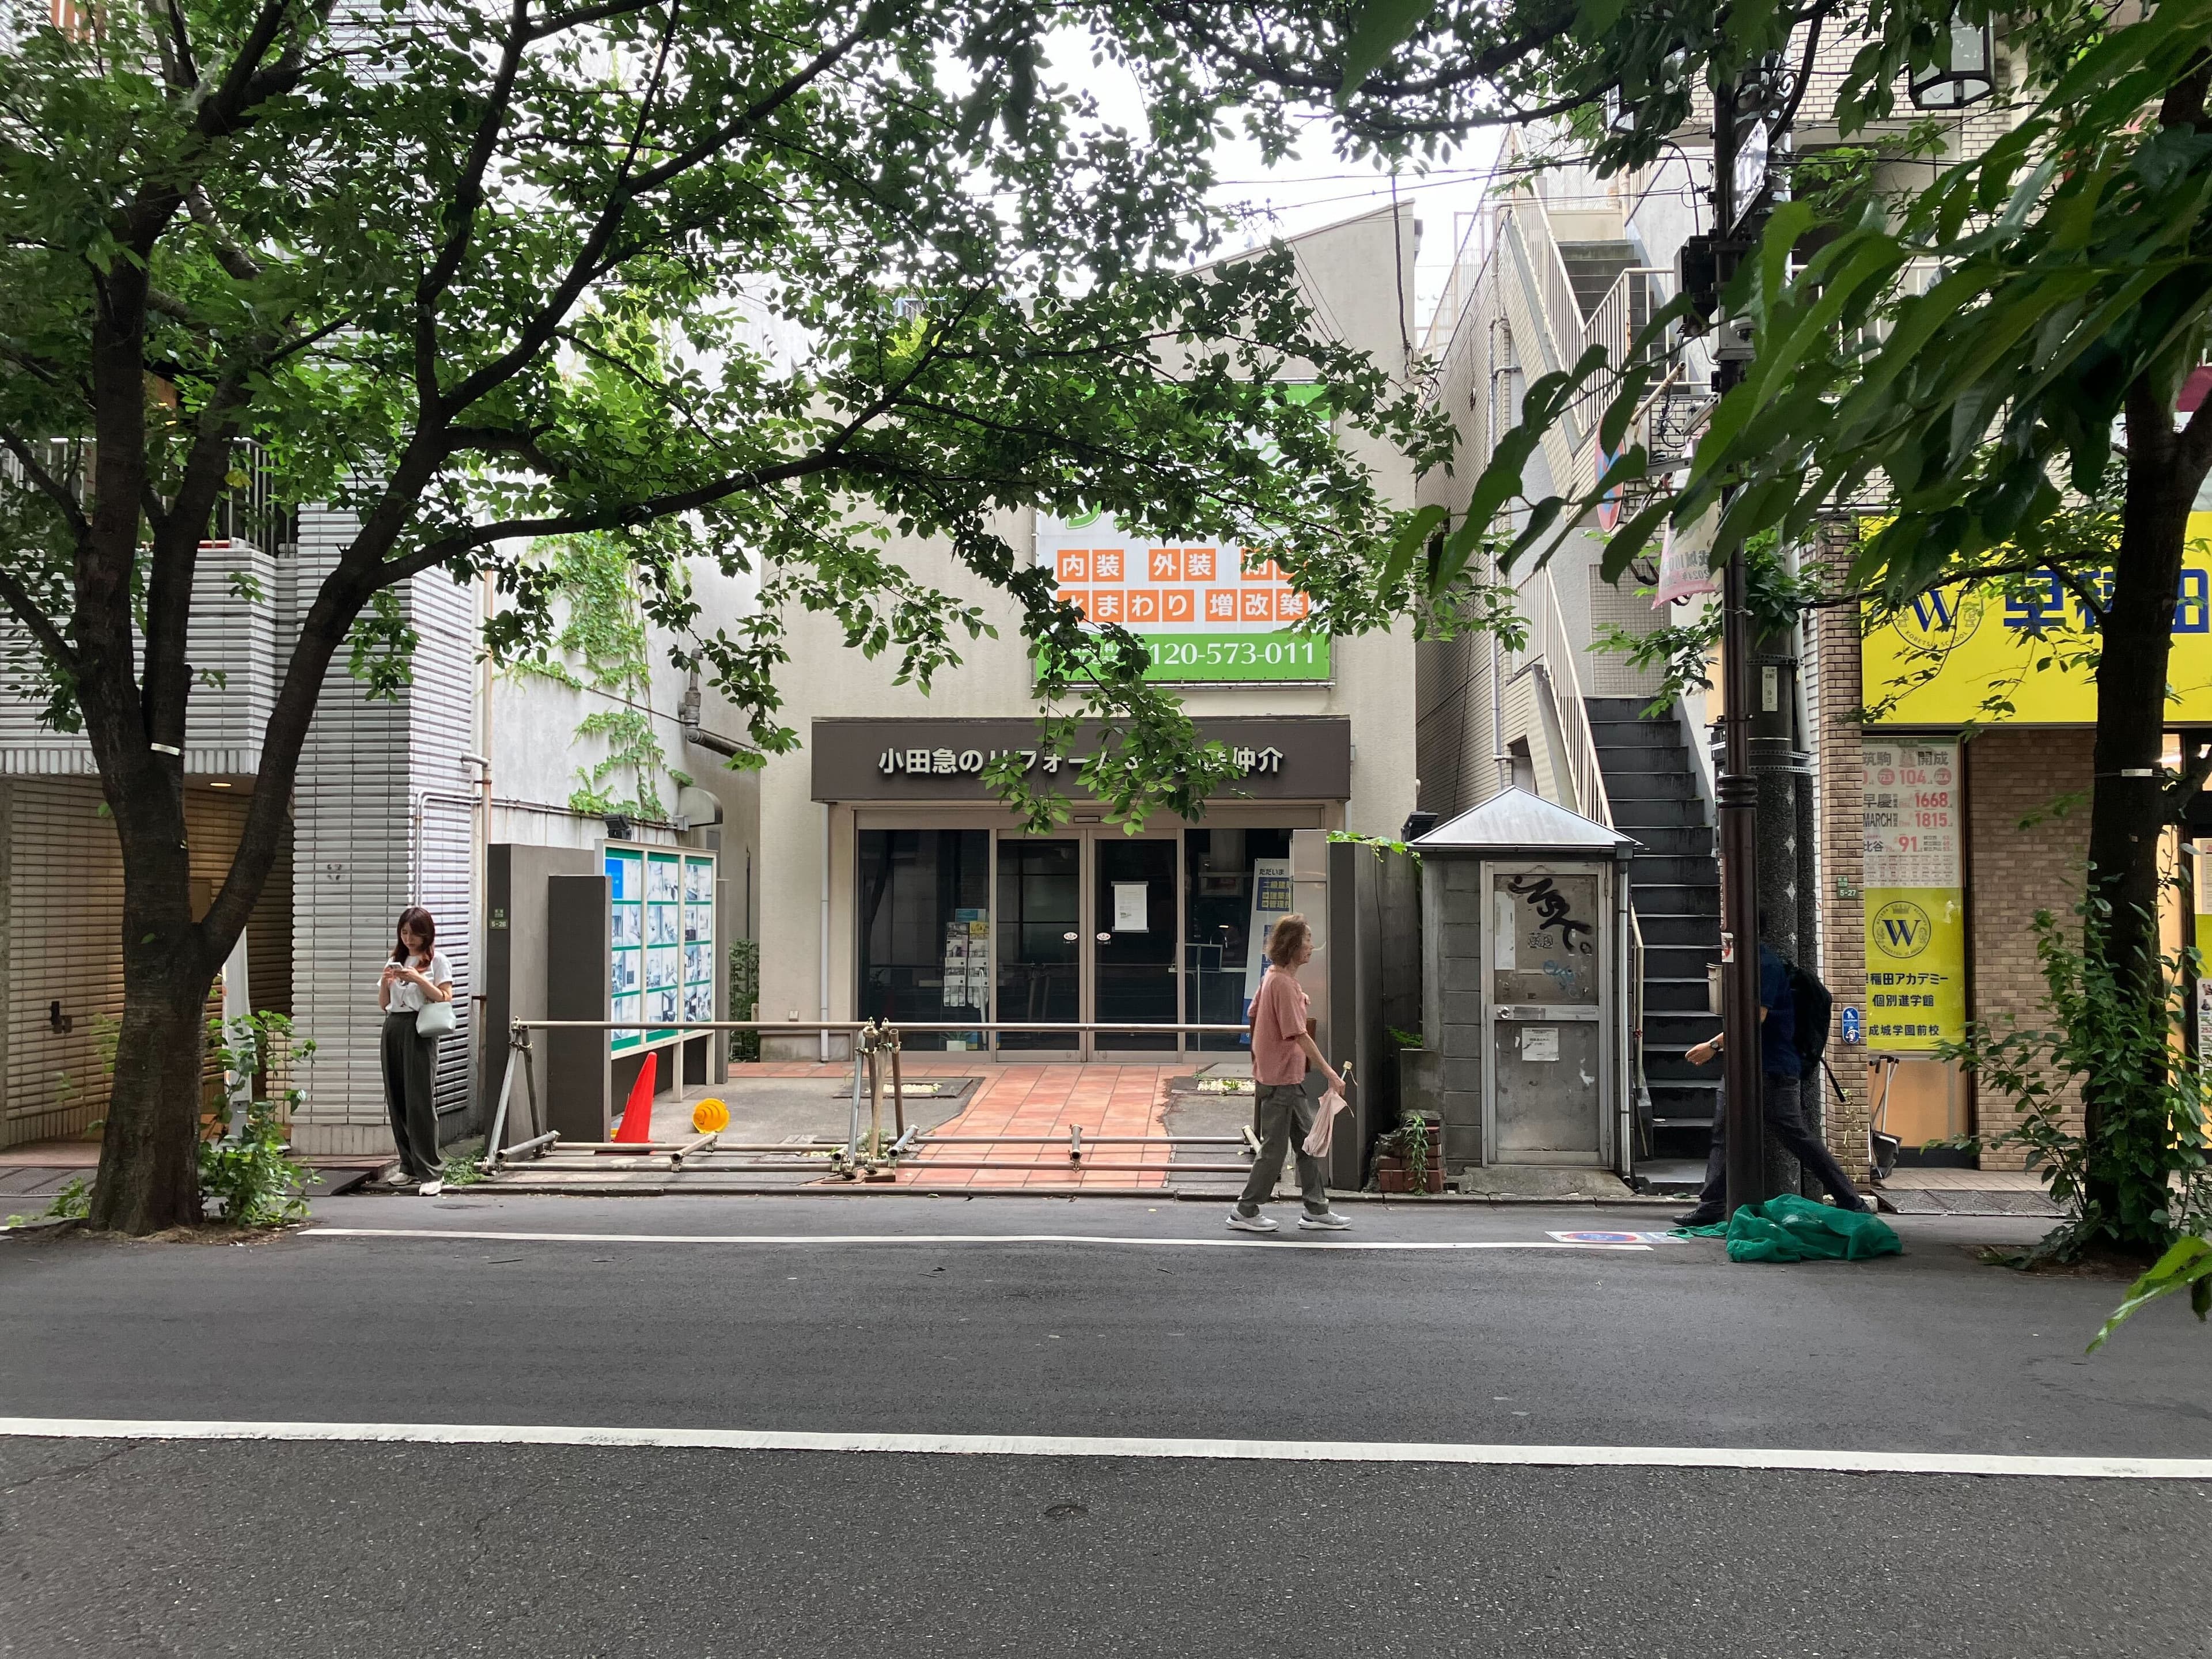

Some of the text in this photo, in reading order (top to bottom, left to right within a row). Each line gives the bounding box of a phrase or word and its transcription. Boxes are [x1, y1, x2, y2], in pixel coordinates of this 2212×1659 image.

[1062, 554, 1212, 577] 内装 外装
[1210, 593, 1304, 616] 増改築
[1149, 642, 1313, 665] 120-573-011
[1863, 793, 1892, 808] 早慶
[1914, 792, 1949, 808] 1668
[1863, 813, 1892, 827] MARCH
[1915, 813, 1948, 827] 1815
[1898, 835, 1918, 853] 91
[1881, 919, 1921, 946] W
[1866, 972, 1949, 986] 稲田アカデミー
[1872, 994, 1934, 1007] 個別進学館
[1869, 1024, 1940, 1036] 成城学園前校
